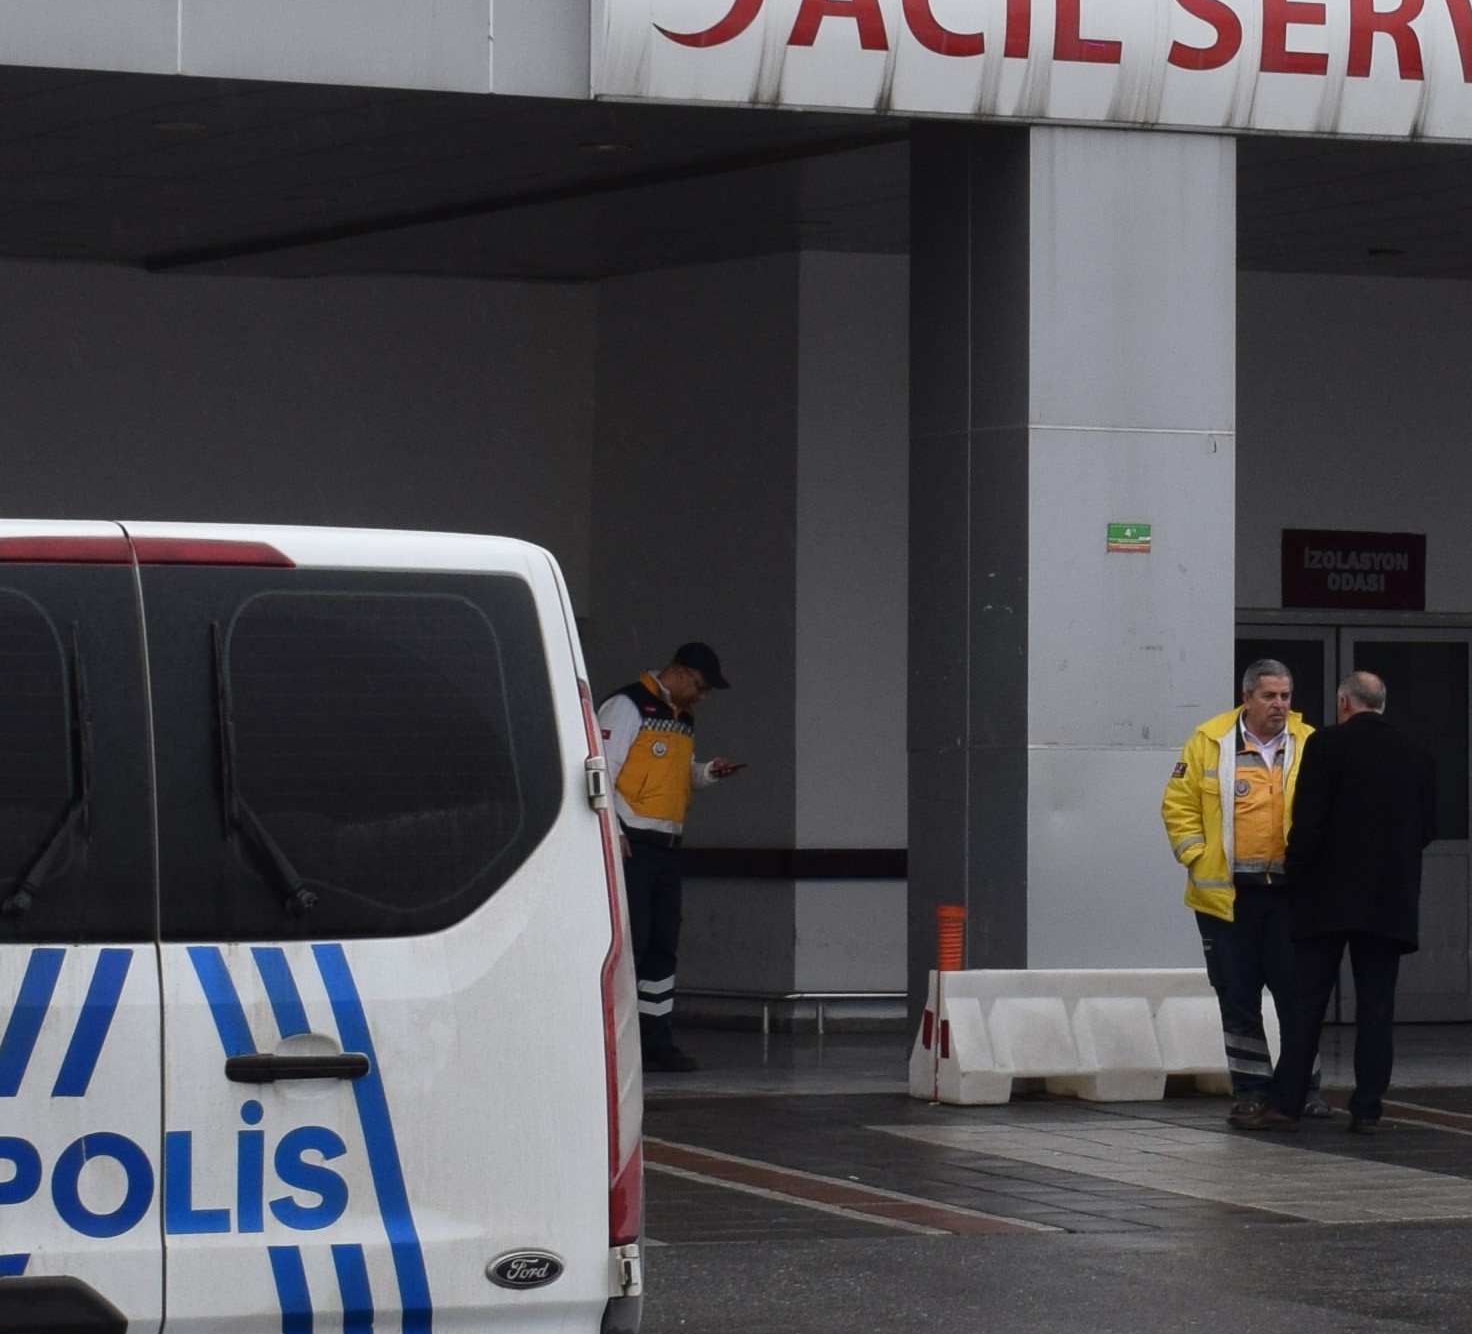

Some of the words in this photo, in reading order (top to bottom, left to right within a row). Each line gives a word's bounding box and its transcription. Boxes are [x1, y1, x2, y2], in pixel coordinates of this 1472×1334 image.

[1304, 546, 1409, 571] İZOLASYON
[1326, 571, 1385, 592] ODASI
[506, 1258, 550, 1280] Ford
